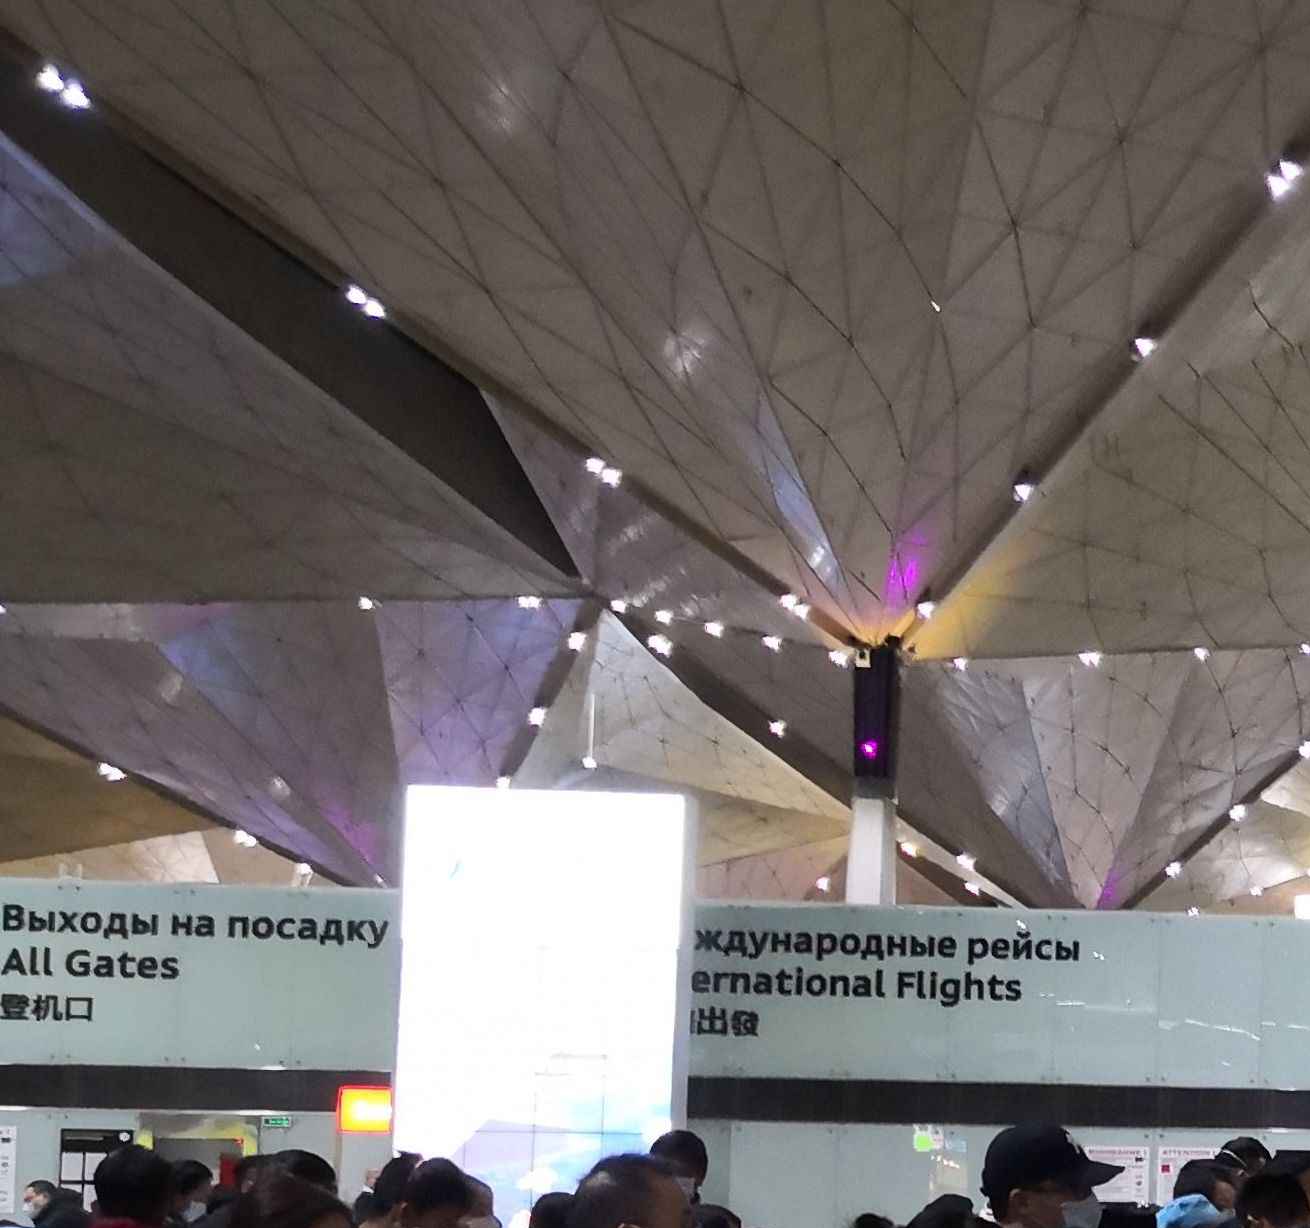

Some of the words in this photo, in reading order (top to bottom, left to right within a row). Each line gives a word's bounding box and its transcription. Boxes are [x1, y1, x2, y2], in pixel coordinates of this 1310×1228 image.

[1, 903, 159, 940] Выходы
[171, 914, 216, 938] на
[228, 915, 389, 949] посадку
[1, 948, 52, 977] All
[66, 949, 180, 980] Gates
[967, 930, 1080, 965] рейсы
[897, 971, 1022, 1007] Flights
[0, 993, 94, 1021] 登机口
